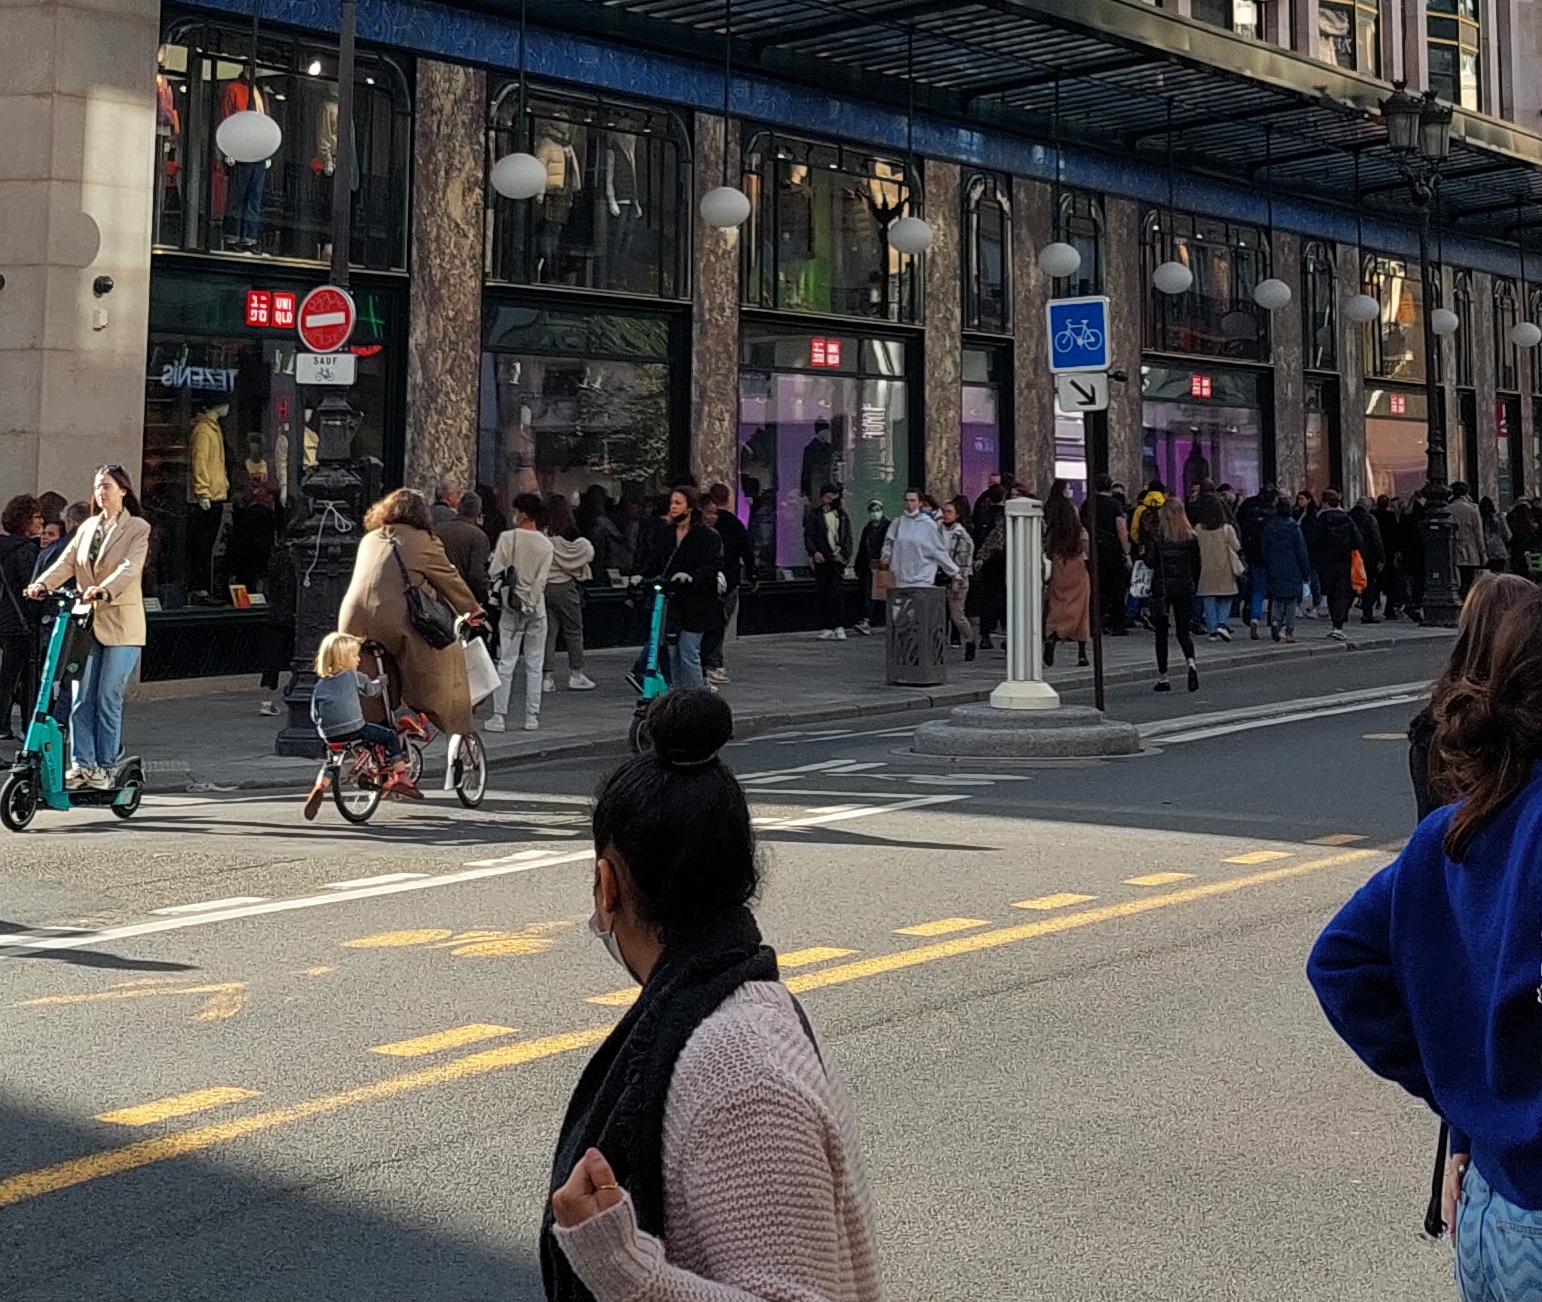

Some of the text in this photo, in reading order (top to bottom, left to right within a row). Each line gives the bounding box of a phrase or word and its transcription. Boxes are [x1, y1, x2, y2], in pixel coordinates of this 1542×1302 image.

[275, 298, 292, 310] UNI
[275, 311, 293, 324] QLO
[313, 356, 337, 365] SAUF
